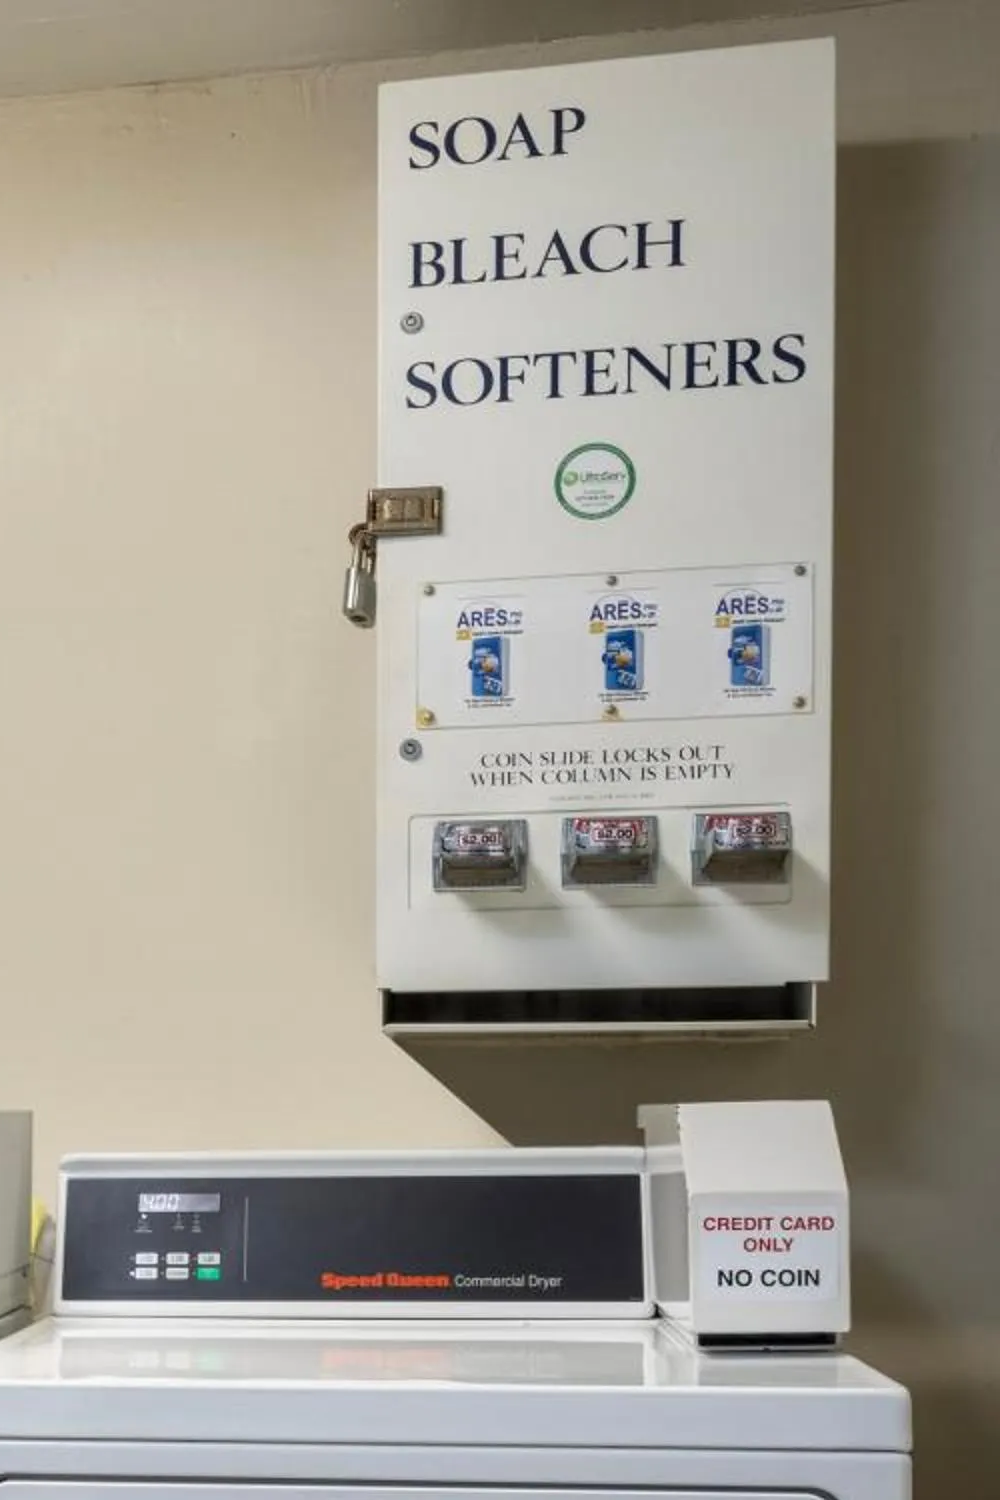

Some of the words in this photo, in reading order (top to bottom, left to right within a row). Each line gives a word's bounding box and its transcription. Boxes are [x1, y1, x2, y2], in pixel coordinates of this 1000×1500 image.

[408, 107, 586, 170] SOAP
[408, 218, 686, 289] BLEACH
[405, 333, 807, 409] SOFTENERS
[480, 751, 534, 769] COIN
[539, 749, 595, 766] SLIDE
[602, 748, 671, 764] LOCKS
[679, 745, 725, 761] OUT
[470, 770, 533, 787] WHEN
[541, 767, 632, 784] COLUMN
[640, 766, 657, 781] IS
[664, 762, 735, 781] EMPTY
[703, 1217, 773, 1231] CREDIT
[780, 1216, 835, 1231] CARD
[743, 1237, 794, 1252] ONLY
[321, 1272, 383, 1290] Speed
[386, 1272, 450, 1287] Queen
[455, 1274, 525, 1287] Commercial
[528, 1274, 562, 1291] Dryer
[717, 1269, 753, 1287] NO
[760, 1269, 820, 1287] COIN
